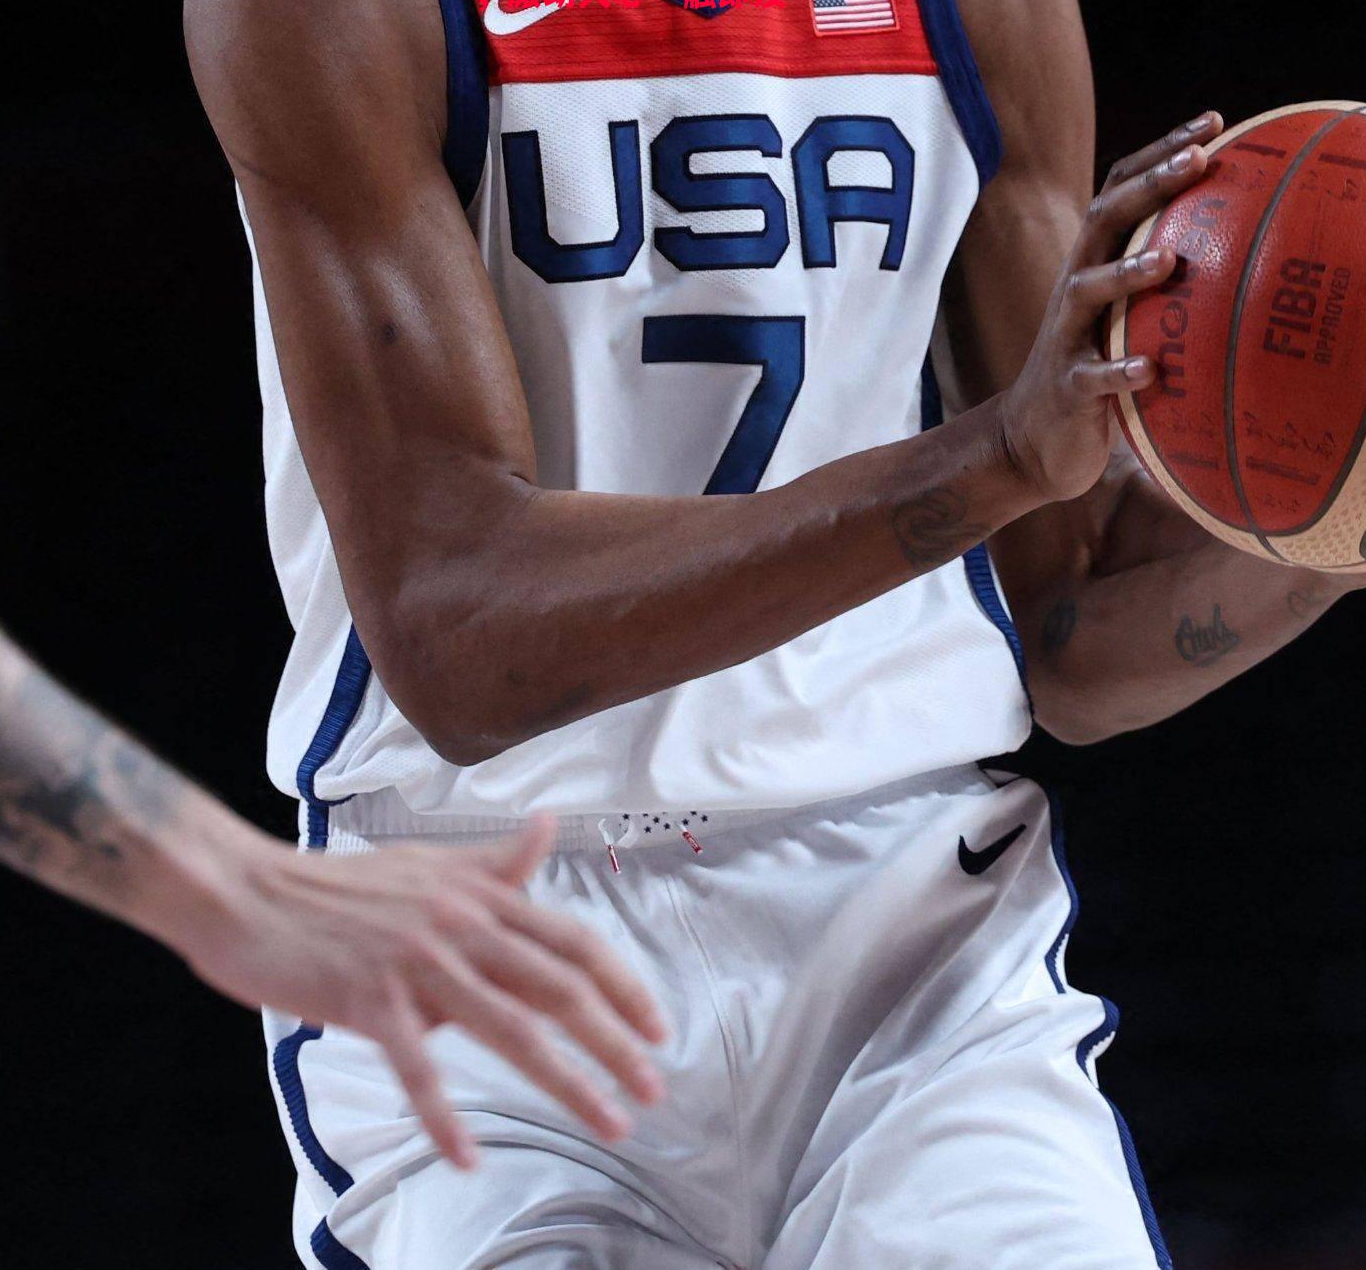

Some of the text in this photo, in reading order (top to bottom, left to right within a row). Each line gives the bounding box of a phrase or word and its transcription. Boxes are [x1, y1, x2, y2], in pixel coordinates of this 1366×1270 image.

[501, 114, 915, 284] USA
[1263, 256, 1327, 361] FIBA
[1313, 267, 1352, 367] APPROVED
[643, 315, 805, 495] 7
